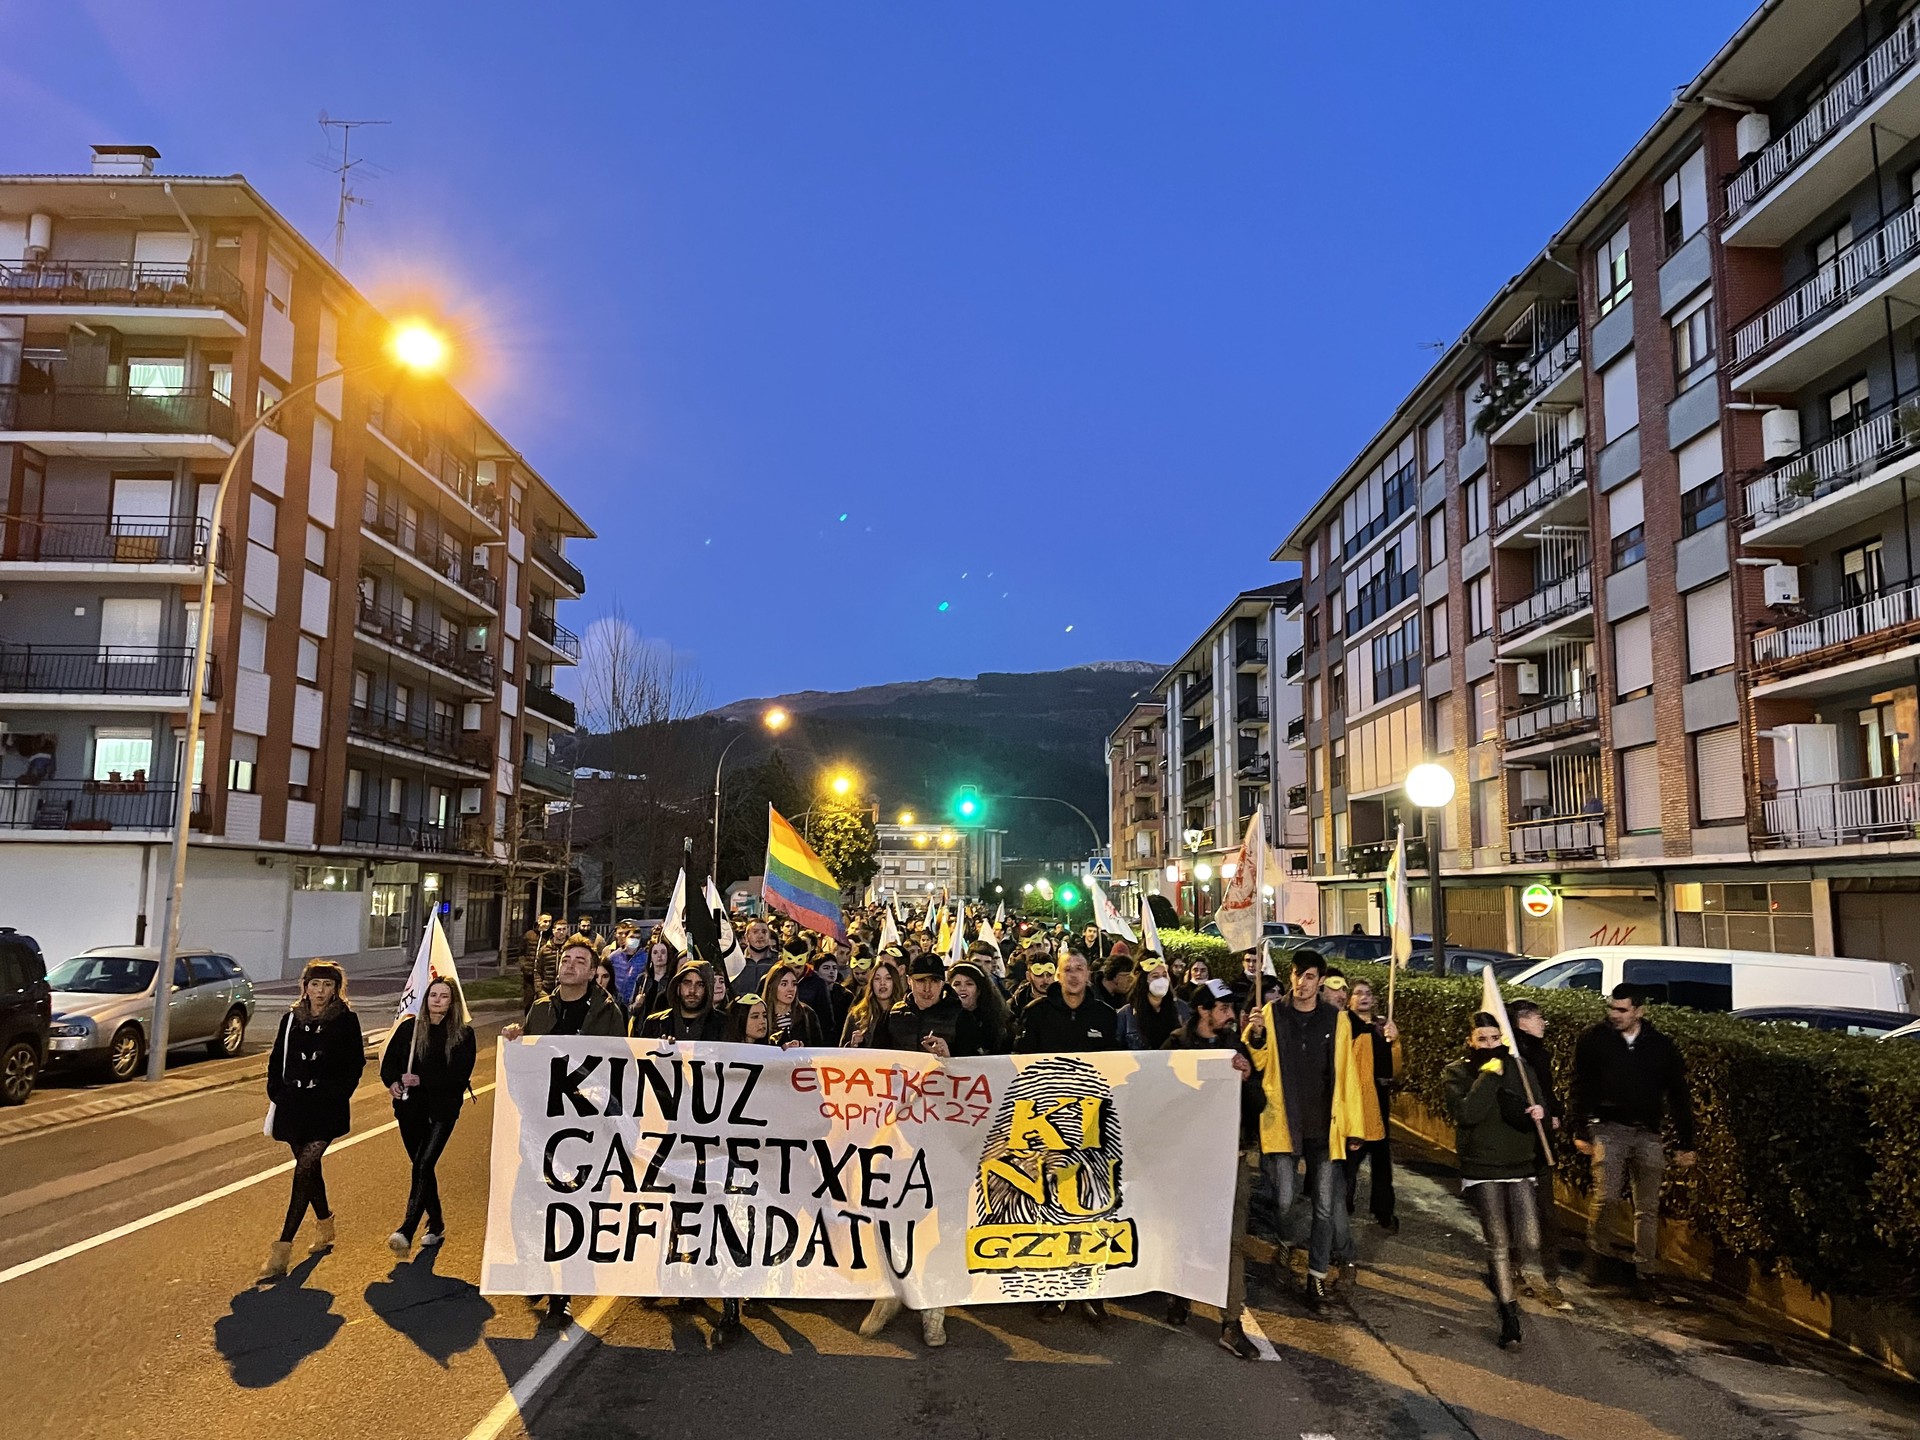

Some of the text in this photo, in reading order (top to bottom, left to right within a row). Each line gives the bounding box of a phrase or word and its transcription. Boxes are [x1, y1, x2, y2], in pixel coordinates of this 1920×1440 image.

[546, 1051, 768, 1127] KIÑUZ
[791, 1066, 993, 1104] EPAIKETA
[819, 1098, 990, 1130] aprilak 27
[543, 1128, 934, 1209] GAZTETXEA
[543, 1201, 915, 1280] DEFENDATU
